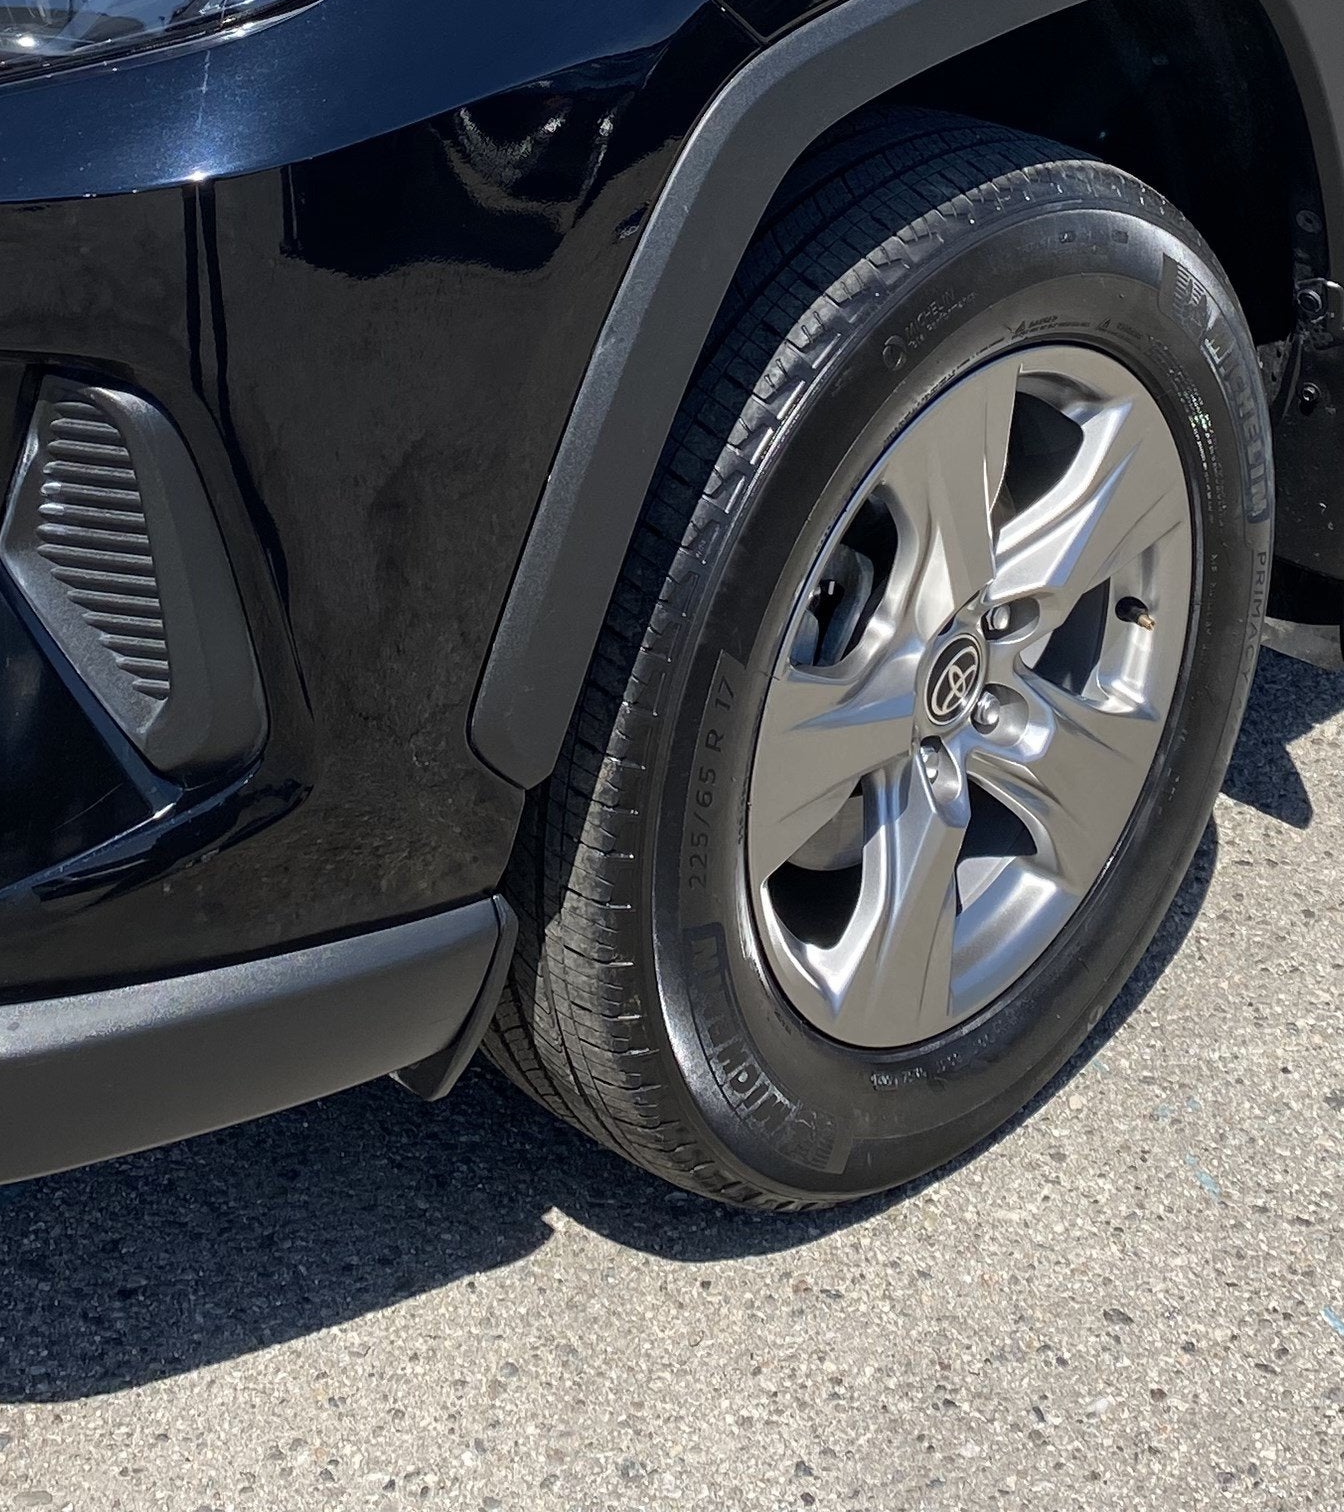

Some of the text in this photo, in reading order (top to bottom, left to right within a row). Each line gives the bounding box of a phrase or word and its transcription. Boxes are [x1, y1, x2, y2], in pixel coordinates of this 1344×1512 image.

[903, 288, 955, 340] MICHELIN
[1203, 314, 1268, 518] MICHELIN
[1241, 549, 1267, 683] PRIMACY
[688, 673, 736, 890] 225/65 R 17
[686, 932, 794, 1140] MICHELIN
